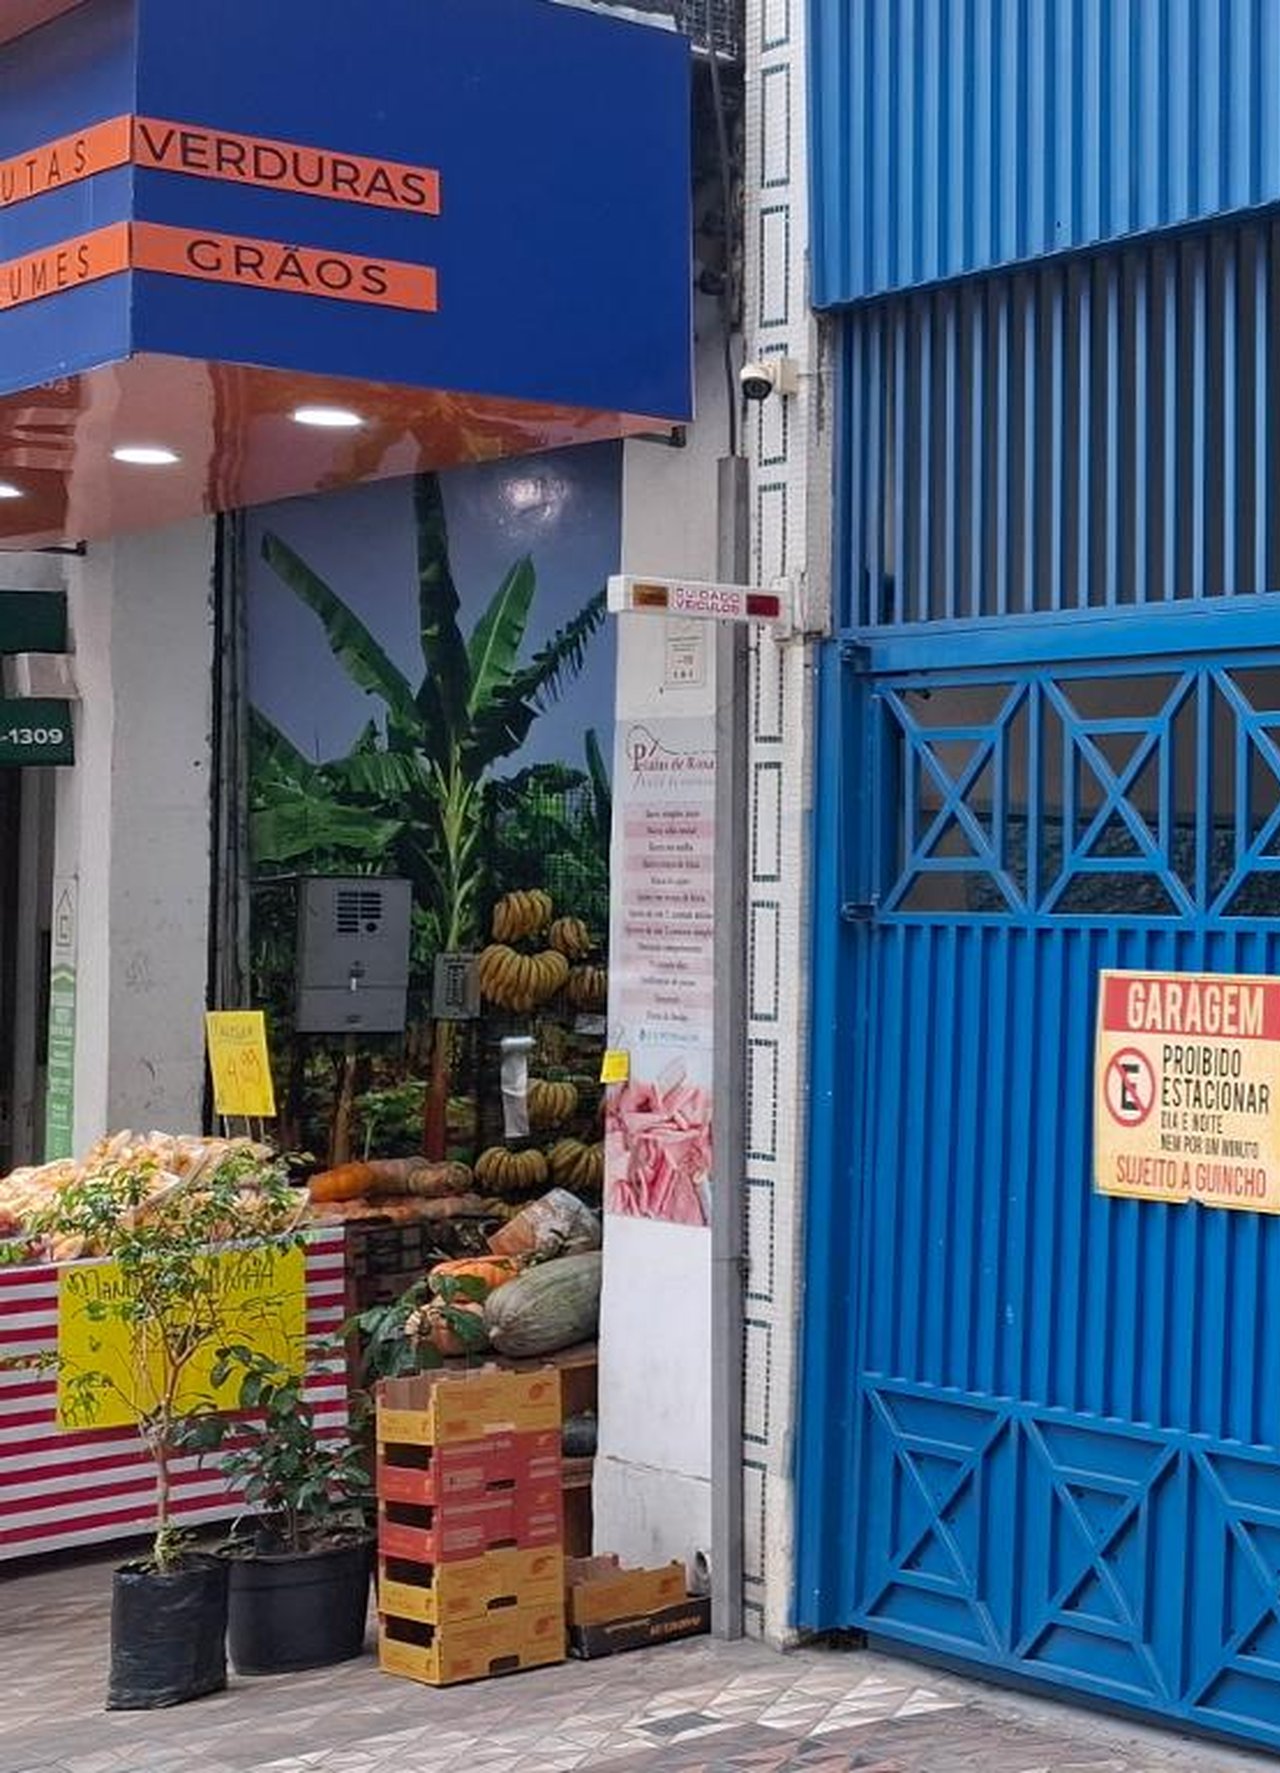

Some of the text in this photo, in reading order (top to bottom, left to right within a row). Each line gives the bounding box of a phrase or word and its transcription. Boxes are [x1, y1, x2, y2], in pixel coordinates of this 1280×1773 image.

[138, 124, 427, 206] VERDURAS
[186, 237, 388, 296] GRÃOS
[1127, 981, 1265, 1036] GARAGEM
[1163, 1044, 1241, 1078] PROIBIDO
[1162, 1078, 1270, 1115] ESTACIONAR
[1160, 1110, 1178, 1130] DIA
[1192, 1113, 1223, 1135] NOITE
[1160, 1133, 1181, 1152] NEM
[1183, 1135, 1202, 1155] POR
[1116, 1154, 1267, 1199] SUJEITO A GUINCHO
